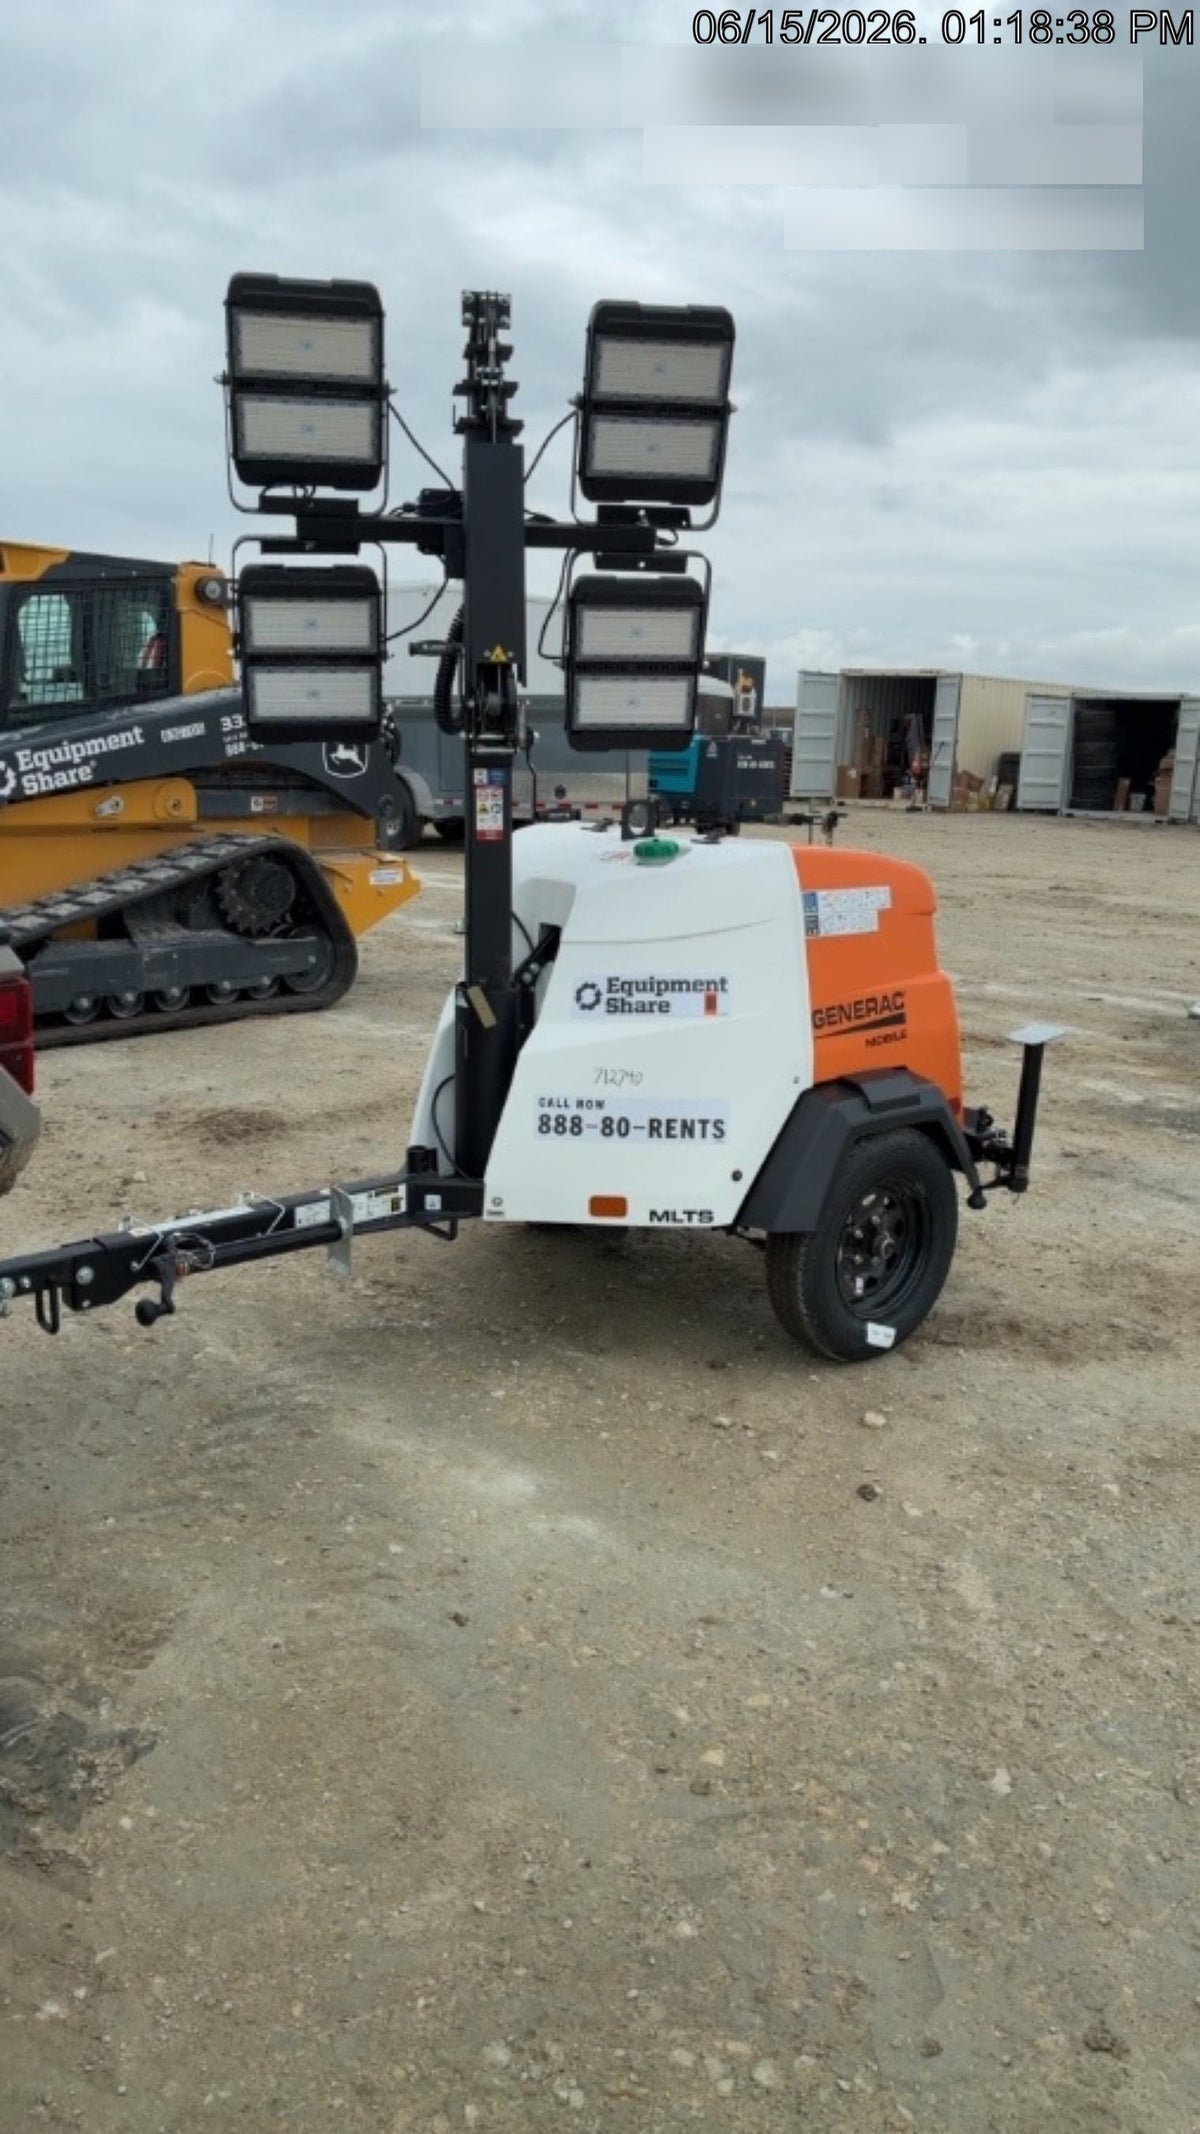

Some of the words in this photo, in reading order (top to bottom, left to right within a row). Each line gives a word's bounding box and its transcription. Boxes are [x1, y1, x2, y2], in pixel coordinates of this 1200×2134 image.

[15, 725, 145, 771] Equipment
[21, 764, 94, 795] Share
[606, 976, 728, 997] Equipment
[606, 998, 670, 1014] Share
[811, 991, 905, 1029] GENERAC
[865, 1029, 908, 1048] MOBILE
[538, 1097, 570, 1109] CALL
[576, 1099, 605, 1111] NOW
[538, 1114, 726, 1140] 888-80-RENTS
[649, 1209, 714, 1224] MLTS
